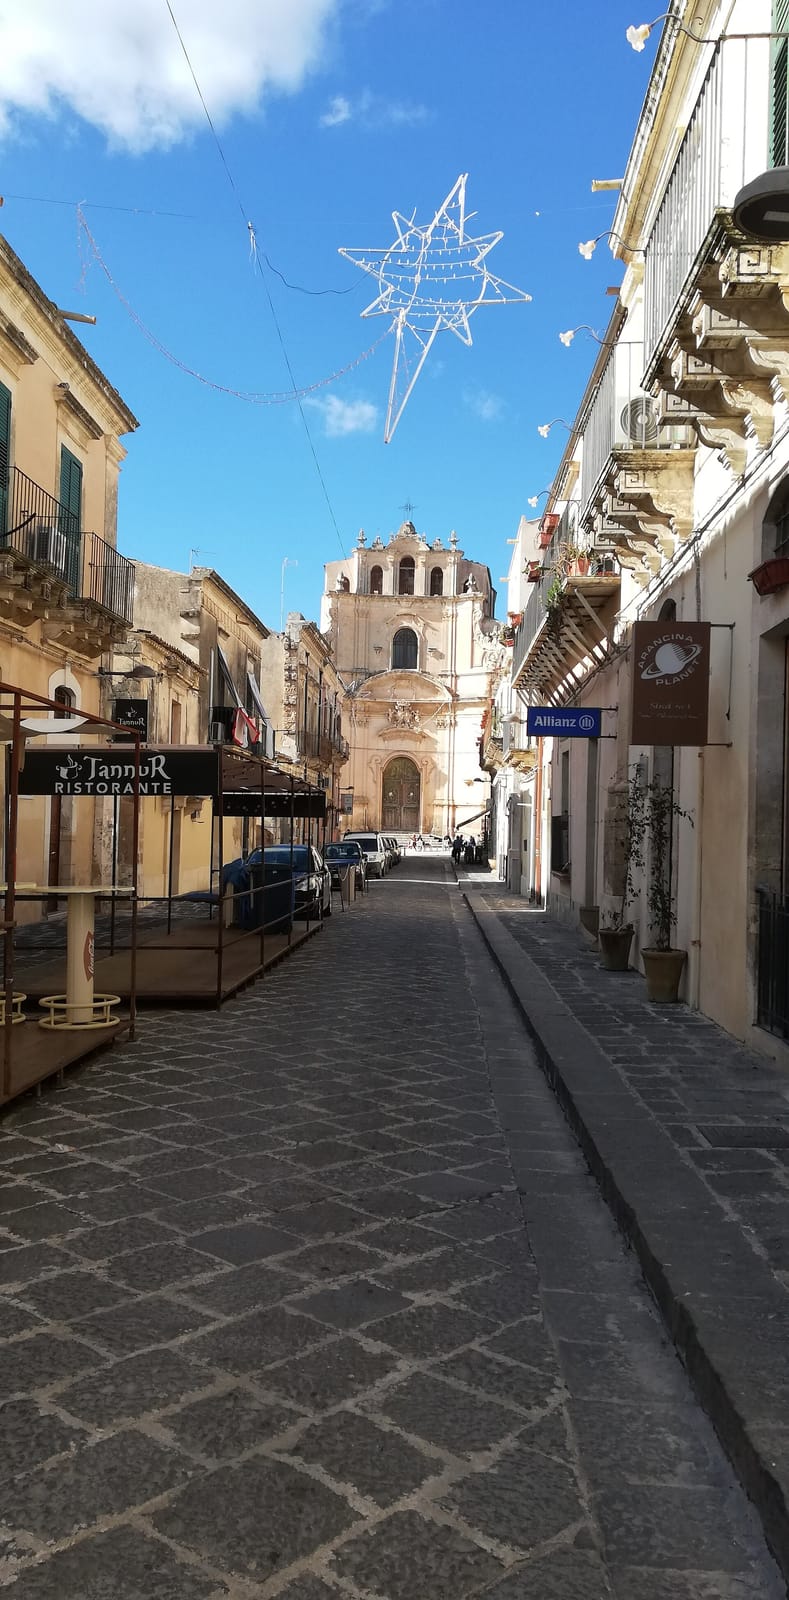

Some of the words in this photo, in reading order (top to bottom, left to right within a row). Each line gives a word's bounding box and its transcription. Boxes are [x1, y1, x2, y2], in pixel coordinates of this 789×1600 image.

[638, 633, 693, 669] ARANCINA
[655, 658, 699, 686] PLANET
[534, 715, 577, 727] Allianz
[55, 782, 172, 794] RISTORANTE
